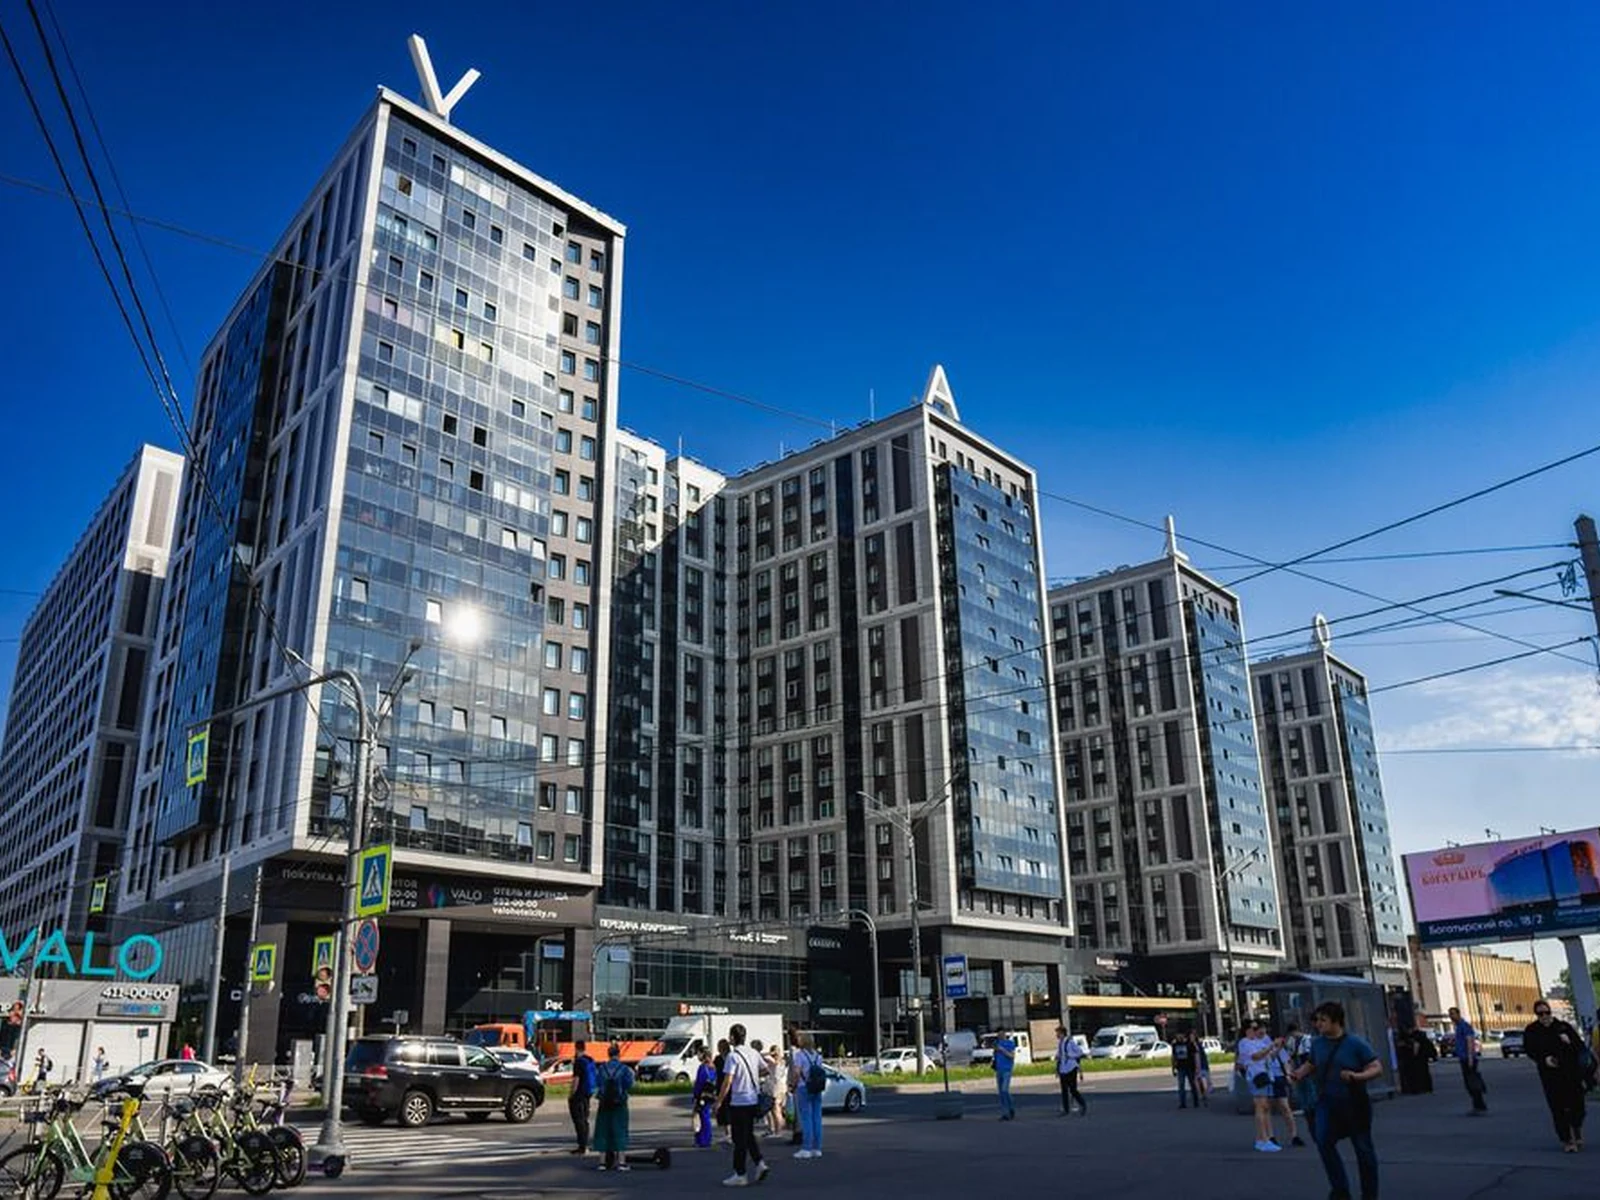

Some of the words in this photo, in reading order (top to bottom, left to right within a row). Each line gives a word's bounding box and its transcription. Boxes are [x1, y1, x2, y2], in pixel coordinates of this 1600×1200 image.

[924, 364, 960, 421] A
[282, 868, 334, 881] ПОКУПКА
[451, 888, 483, 901] VALO
[493, 886, 523, 897] ОТЕЛЬ
[524, 888, 533, 898] И
[533, 890, 569, 901] АРЕНДА
[0, 924, 163, 980] VALO
